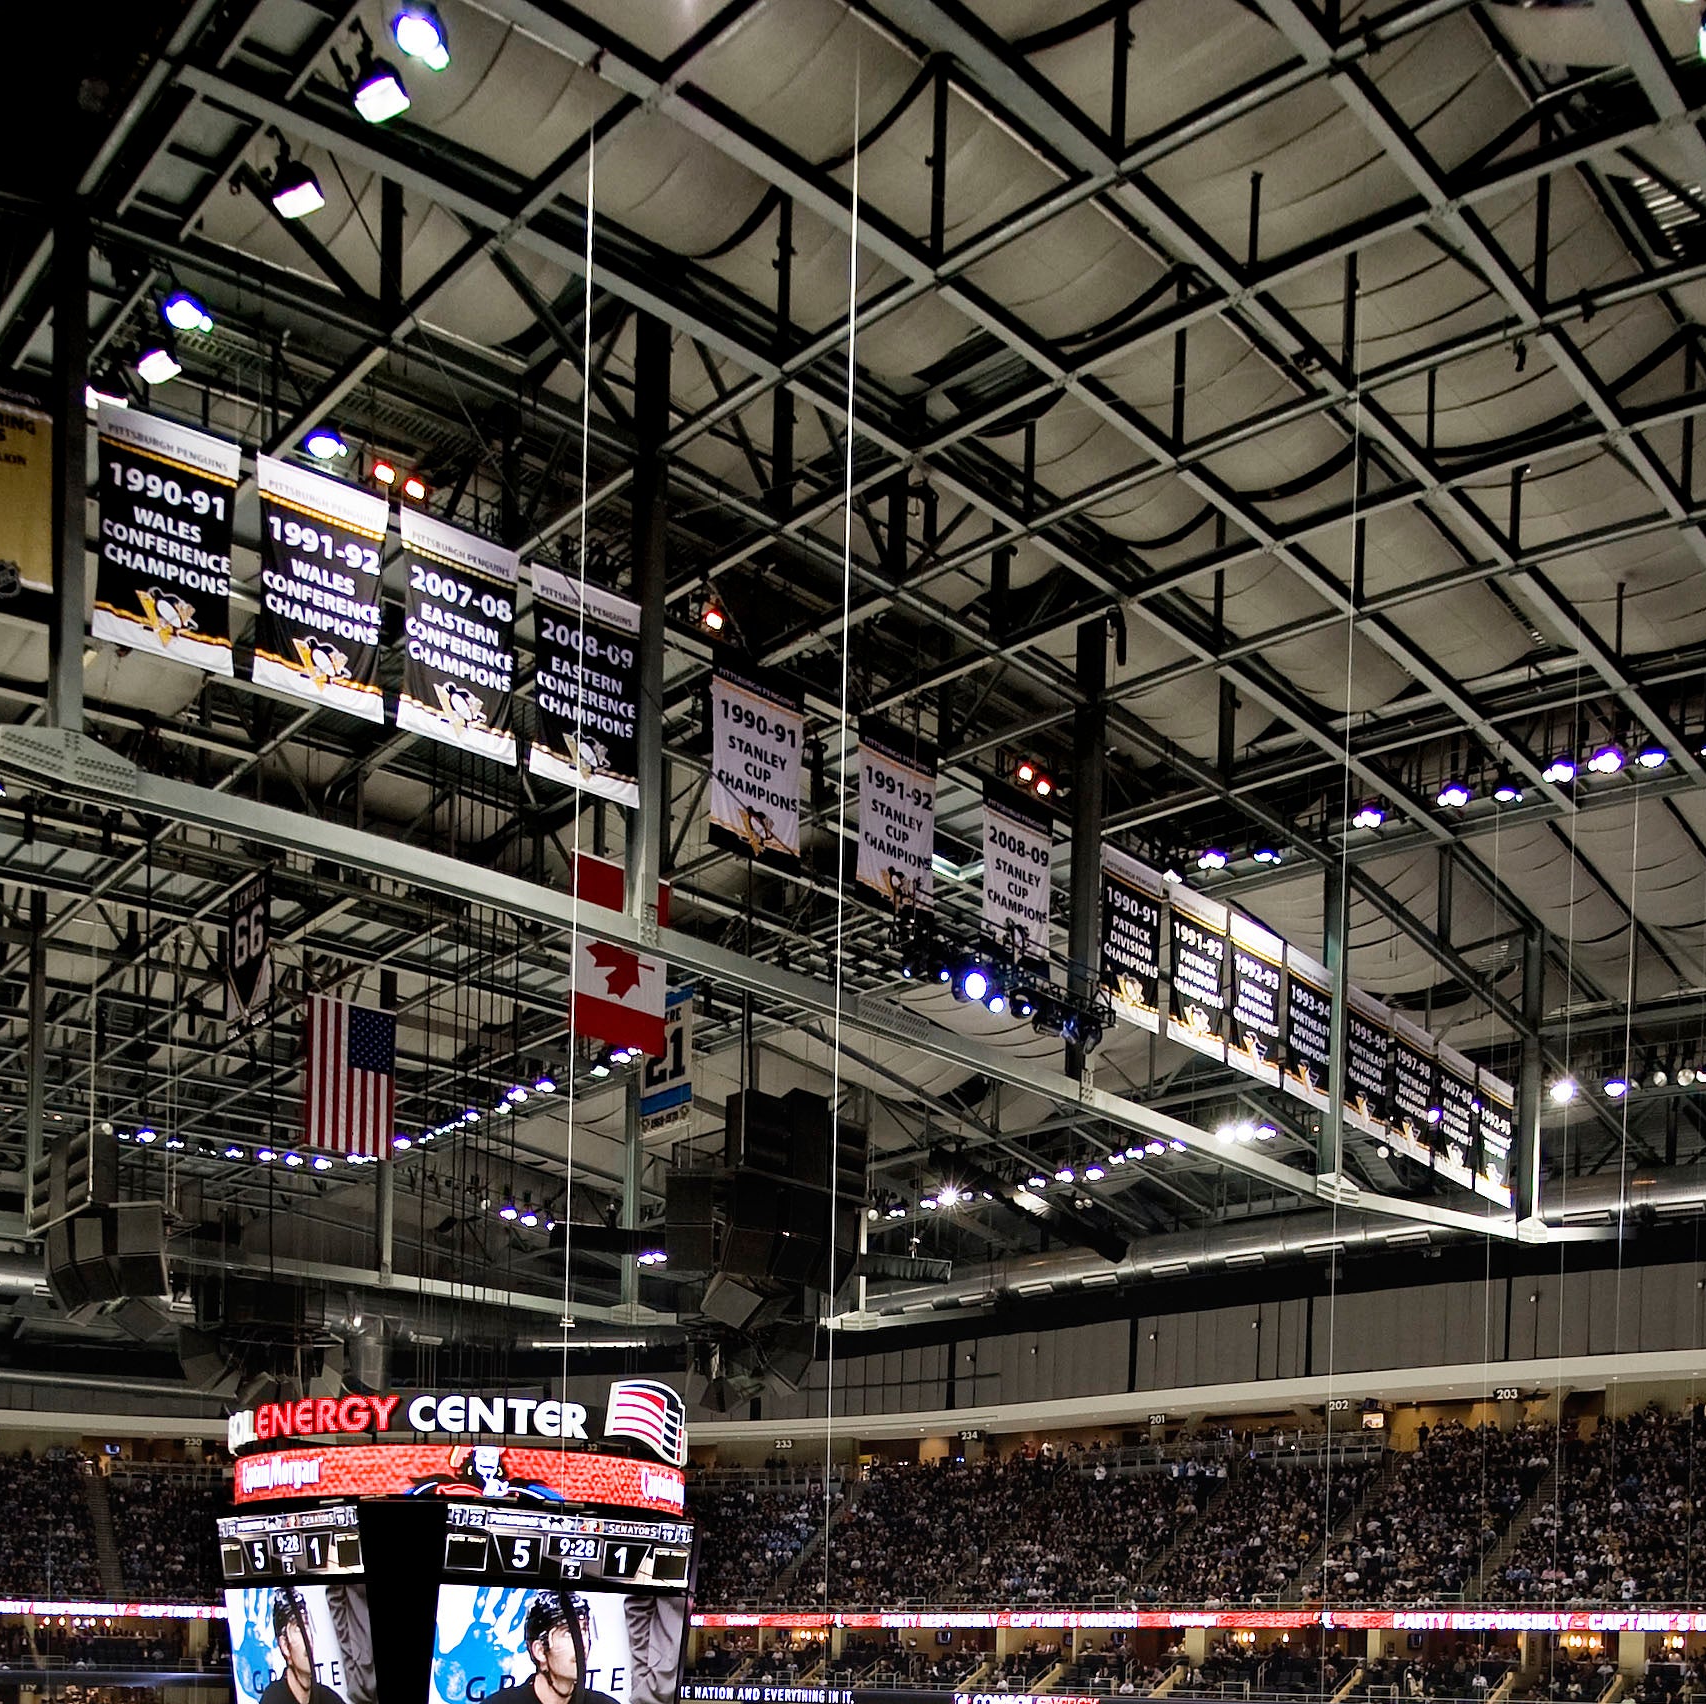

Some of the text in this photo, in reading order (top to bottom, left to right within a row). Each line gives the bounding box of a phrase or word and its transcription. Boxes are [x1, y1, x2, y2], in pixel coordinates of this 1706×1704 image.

[107, 422, 229, 472] PITTSBURGH PENGUINS
[110, 462, 225, 521] 1990-91
[133, 505, 202, 543] WALES
[102, 517, 231, 575] CONFERENCE
[268, 516, 381, 576] 1991-92
[104, 542, 229, 597] CHAMPIONS
[291, 558, 356, 597] WALES
[262, 570, 382, 626] CONFERENCE
[409, 564, 513, 623] 2007-08
[265, 594, 379, 647] CHAMPIONS
[420, 602, 500, 648] EASTERN
[404, 616, 513, 672] CONFERENCE
[541, 616, 634, 670] 2008-09
[408, 640, 512, 693] CHAMPIONS
[551, 655, 623, 696] EASTERN
[537, 670, 636, 720] CONFERENCE
[539, 693, 634, 739] CHAMPIONS
[721, 699, 796, 748] 1990-91
[728, 735, 787, 771] STANLEY
[744, 762, 771, 783] CUP
[866, 765, 933, 811] 1991-92
[718, 769, 798, 813] CHAMPIONS
[871, 799, 923, 832] STANLEY
[885, 824, 909, 844] CUP
[989, 825, 1049, 867] 2008-09
[864, 831, 932, 871] CHAMPIONS
[995, 858, 1041, 888] STANLEY
[987, 889, 1048, 924] CHAMPIONS
[1007, 882, 1028, 899] CUP
[1106, 886, 1158, 927] 1990-91
[1110, 930, 1152, 962] DIVISION
[1113, 915, 1150, 945] PATRICK
[1174, 921, 1224, 960] 1991-92
[1104, 942, 1158, 979] CHAMPIONS
[1180, 948, 1217, 978] PATRICK
[1234, 954, 1279, 990] 1992-93
[1173, 977, 1224, 1010] CHAMPIONS
[1178, 965, 1218, 997] DIVISION
[1240, 980, 1272, 1006] PATRICK
[1238, 994, 1273, 1022] DIVISION
[1291, 985, 1331, 1018] 1993-94
[1233, 1006, 1279, 1038] CHAMPIONS
[1289, 1004, 1331, 1038] NORTHEAST
[1294, 1020, 1326, 1050] DIVISION
[1350, 1019, 1387, 1052] 1995-96
[1289, 1035, 1330, 1067] CHAMPIONS
[1348, 1039, 1386, 1069] NORTHEAST
[1396, 1048, 1431, 1079] 1997-98
[1352, 1055, 1382, 1081] DIVISION
[1398, 1084, 1427, 1107] DIVISION
[1329, 1401, 1349, 1411] 202
[1496, 1389, 1518, 1399] 203
[256, 1394, 589, 1440] ENERGY CENTER
[1150, 1415, 1166, 1425] 201
[961, 1431, 978, 1440] 234
[271, 1456, 320, 1490] Morgan
[469, 1514, 483, 1526] 22
[608, 1524, 658, 1537] SENATORS
[662, 1528, 675, 1540] 19
[253, 1542, 265, 1569] 5
[277, 1534, 299, 1554] 9:28
[310, 1537, 321, 1565] 1
[512, 1539, 530, 1568] 5
[559, 1538, 595, 1557] 9:28
[614, 1547, 628, 1574] 1
[881, 1613, 918, 1627] PARTY
[1393, 1613, 1448, 1630] PARTY
[1452, 1614, 1573, 1630] RESPONSIBLY
[1589, 1614, 1689, 1631] CAPTAIN'S
[695, 1687, 839, 1704] NATION AND EVERYTHING IN
